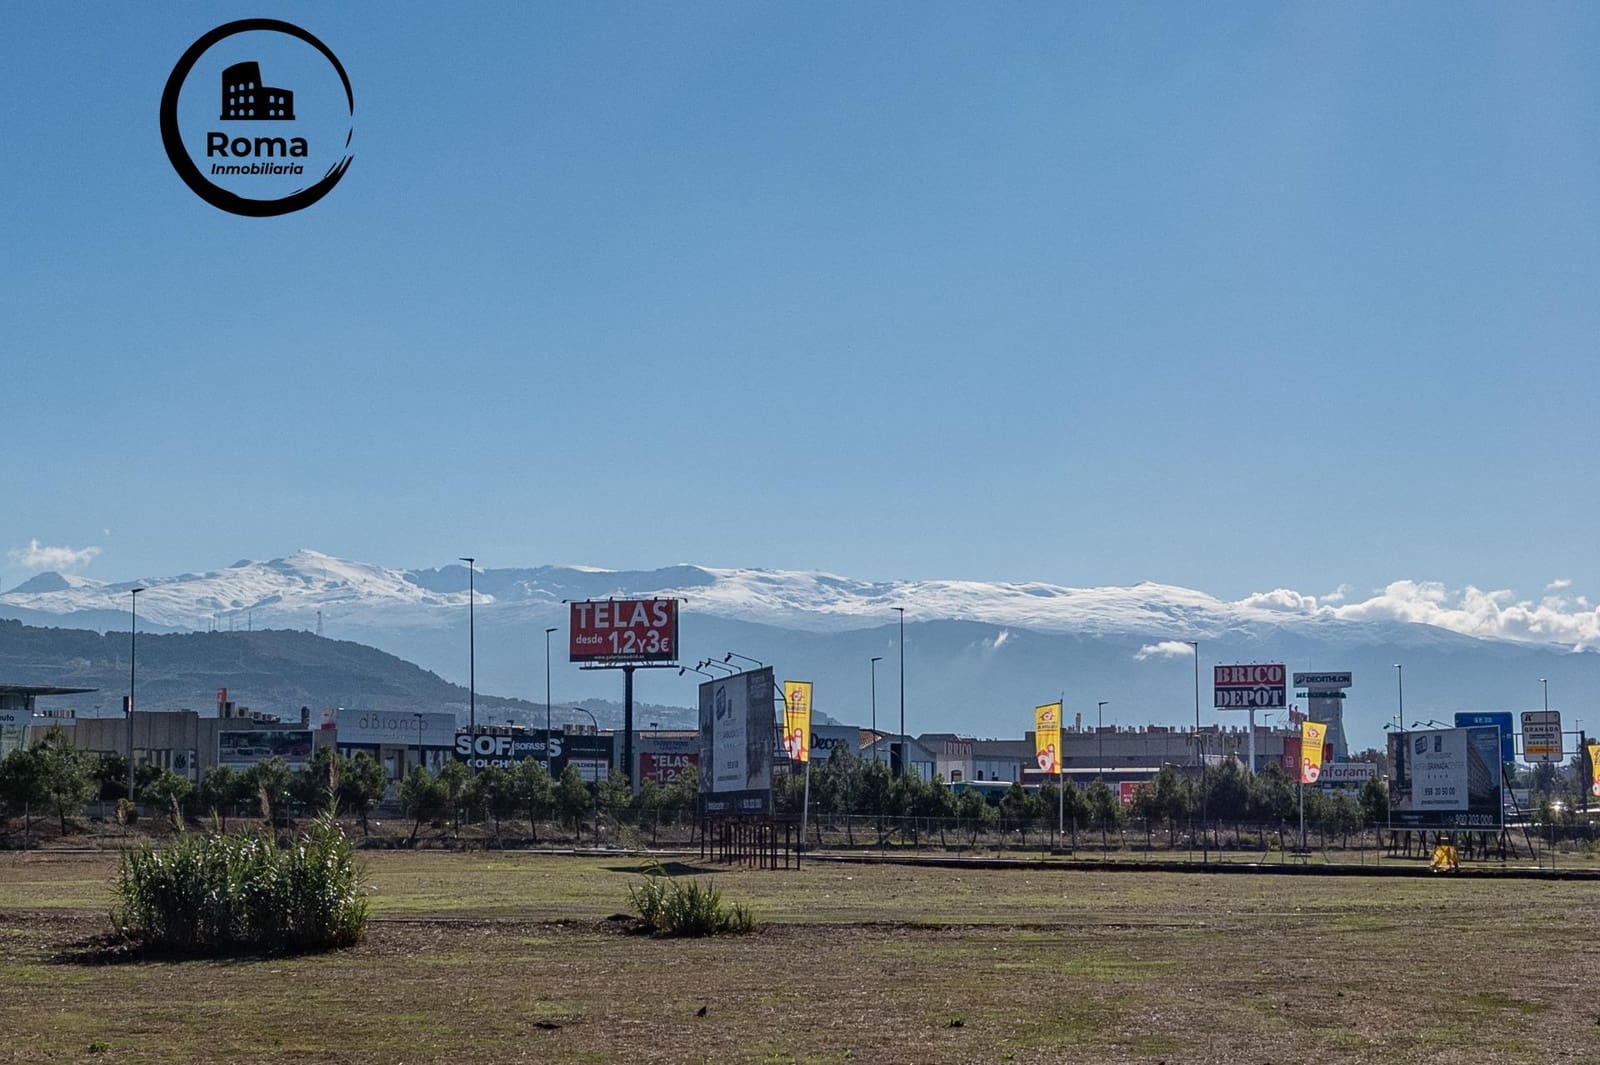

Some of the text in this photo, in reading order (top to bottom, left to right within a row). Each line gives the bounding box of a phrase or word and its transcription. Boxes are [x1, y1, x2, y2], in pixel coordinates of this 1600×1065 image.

[575, 601, 668, 629] TELAS
[576, 633, 603, 644] desde
[1216, 666, 1282, 683] BRICO
[1306, 675, 1350, 683] DECATHLON
